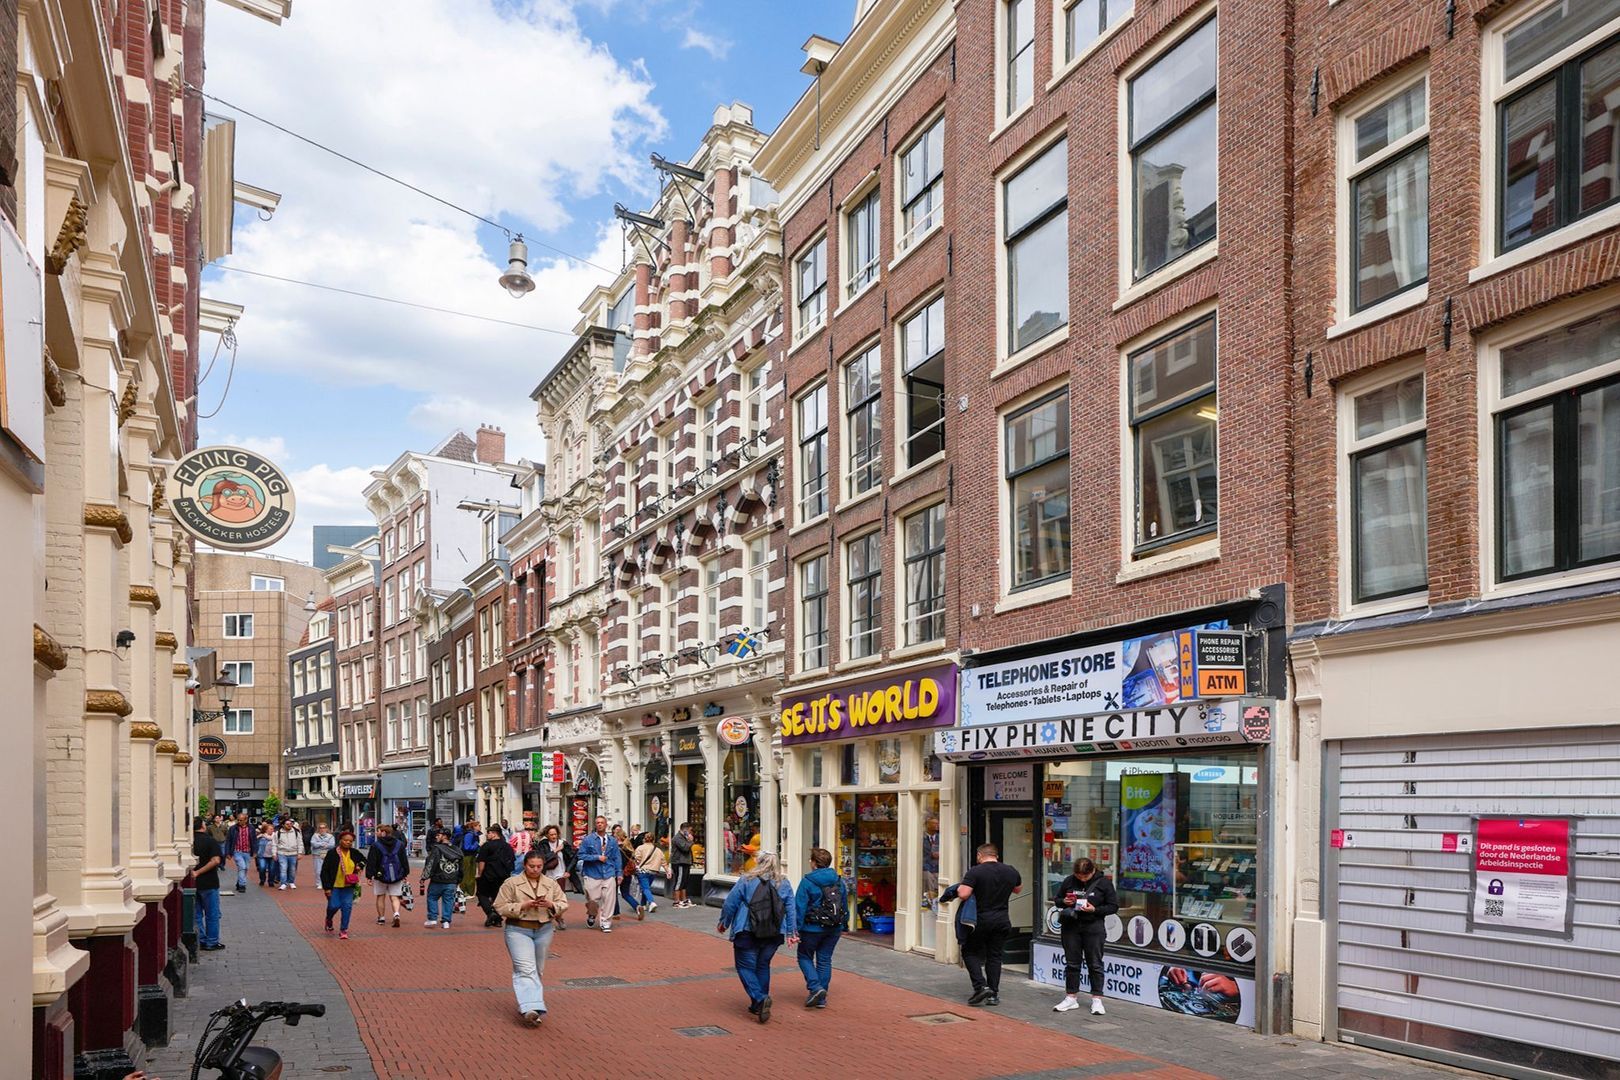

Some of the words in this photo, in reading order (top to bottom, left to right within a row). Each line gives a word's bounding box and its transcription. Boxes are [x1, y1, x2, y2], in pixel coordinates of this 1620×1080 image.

[176, 450, 249, 484] FLYING
[253, 463, 286, 493] PIG
[179, 500, 243, 540] BACKPACKER
[245, 510, 283, 538] HOSTELS
[1199, 638, 1219, 646] PHONE
[1220, 638, 1240, 646] REPAIR
[1201, 646, 1239, 654] ACCESSORIES
[977, 662, 1059, 690] TELEPHONE
[1061, 651, 1116, 677] STORE
[1182, 644, 1192, 686] ATM
[996, 685, 1042, 701] Accessories
[1043, 684, 1050, 693] &
[1050, 682, 1078, 694] Repair
[1079, 679, 1089, 689] of
[1206, 675, 1238, 690] ATM
[781, 694, 841, 737] SEJI'S
[848, 678, 939, 728] WORLD
[986, 701, 1028, 712] Telephones
[1032, 695, 1062, 706] Tablets
[1066, 690, 1102, 703] Laptops
[961, 728, 998, 750] FIX
[1105, 707, 1188, 739] CITY
[1033, 746, 1069, 755] HUAWEI
[1134, 739, 1170, 748] xiaomi
[992, 771, 1028, 780] WELCOME
[1046, 783, 1062, 791] ATM
[1126, 787, 1150, 799] Bite
[1521, 845, 1556, 853] gesloten
[1480, 860, 1544, 870] Arbeidsinspectie
[1510, 853, 1561, 862] Nederlandse
[1103, 962, 1142, 979] APTOP
[1107, 979, 1140, 996] STORE
